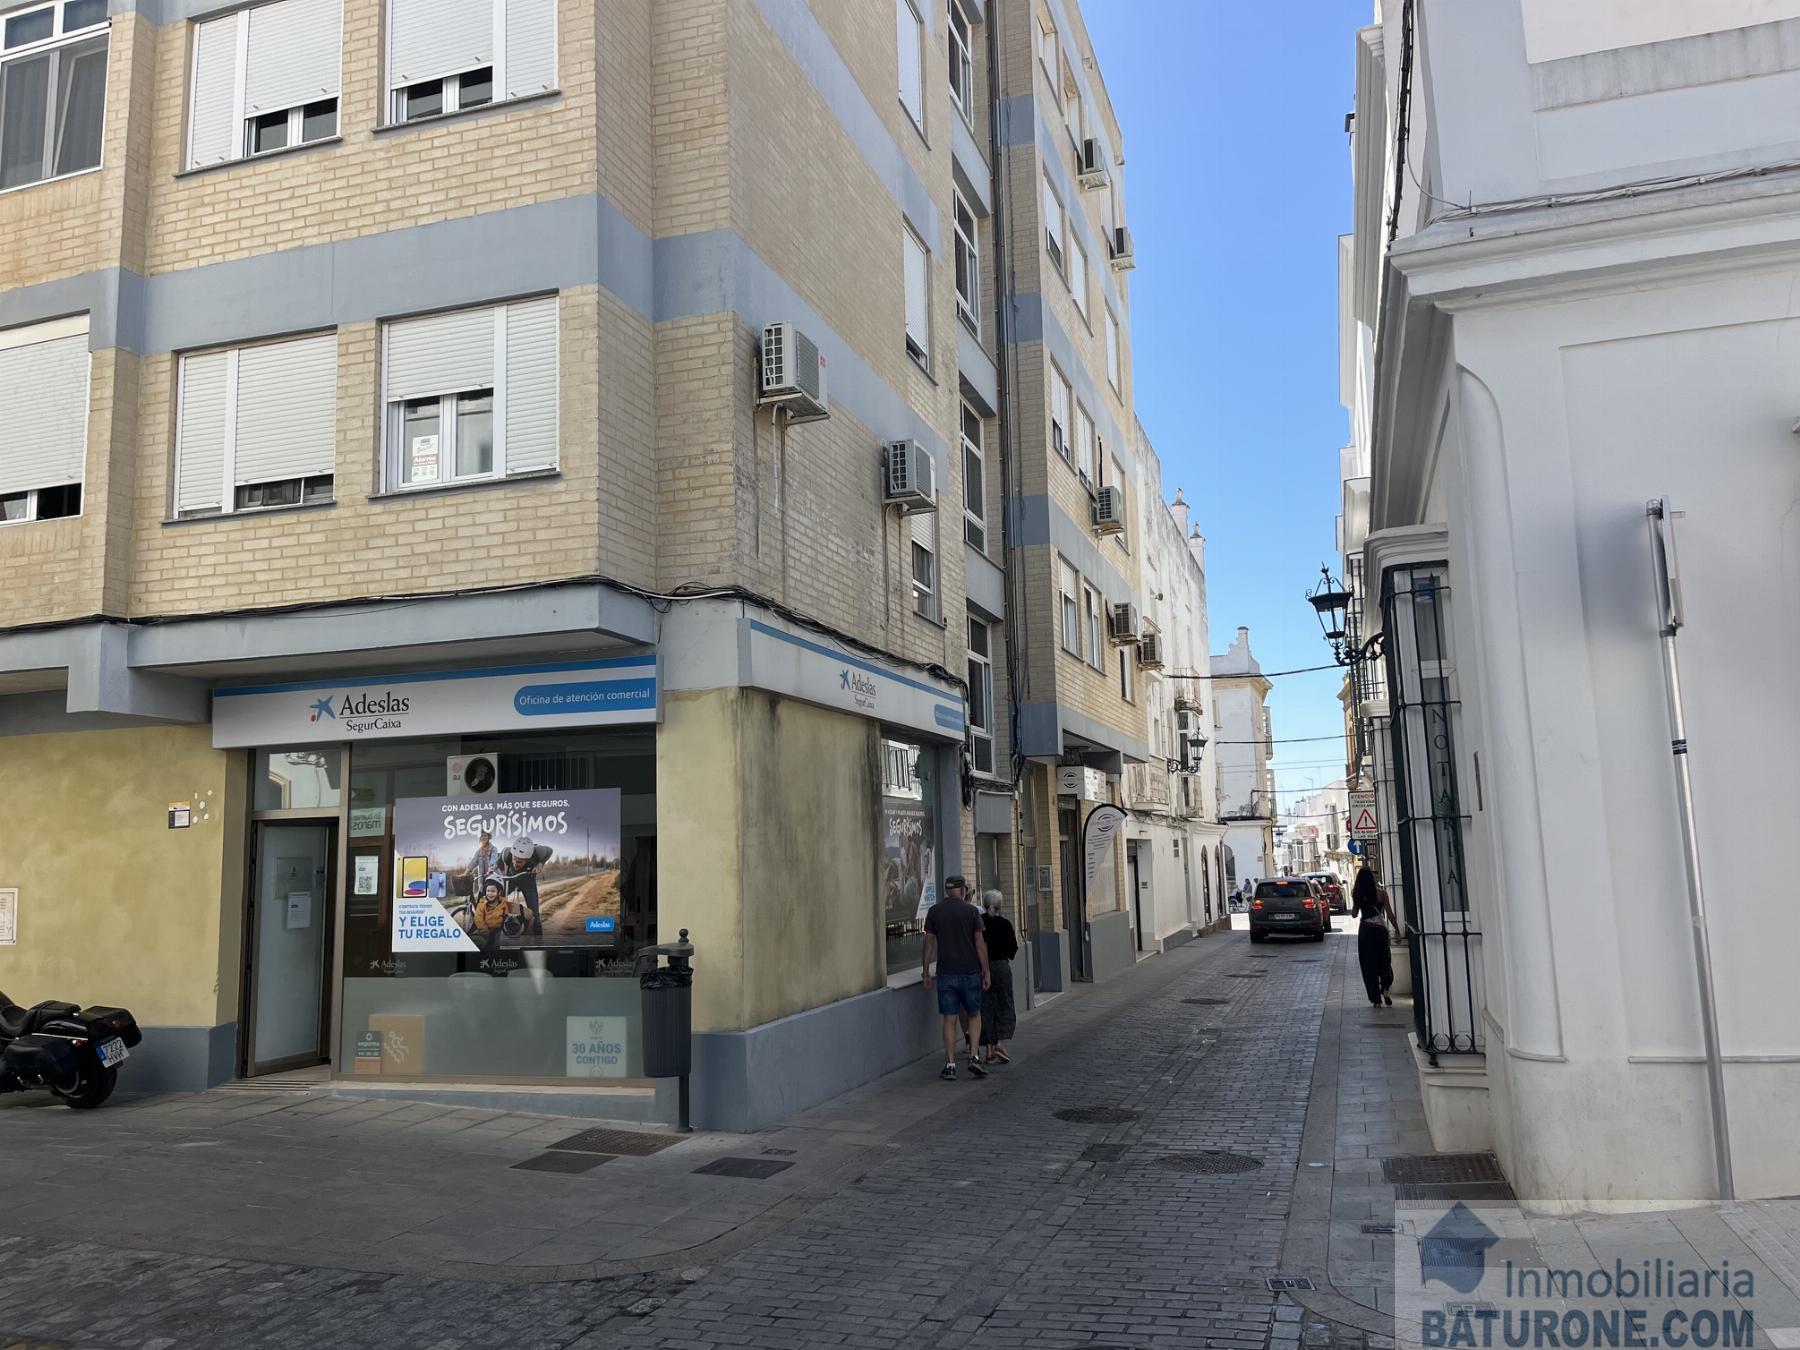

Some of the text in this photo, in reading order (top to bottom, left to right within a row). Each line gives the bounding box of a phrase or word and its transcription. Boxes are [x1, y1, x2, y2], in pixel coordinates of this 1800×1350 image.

[852, 671, 877, 696] Adeslas
[519, 688, 650, 706] Oficina de atención comercial
[339, 691, 410, 716] Adeslas
[346, 717, 402, 733] SegurCaixa
[441, 804, 458, 812] CON
[496, 801, 513, 810] MÁS
[514, 801, 530, 809] QUE
[399, 916, 445, 927] Y ELIGE
[590, 920, 611, 928] Adeslas
[398, 928, 461, 939] TU REGALO
[380, 958, 407, 969] Adeslas
[490, 957, 518, 969] Adeslas
[571, 1040, 622, 1055] 30 AÑOS
[576, 1055, 618, 1065] CONTIGO
